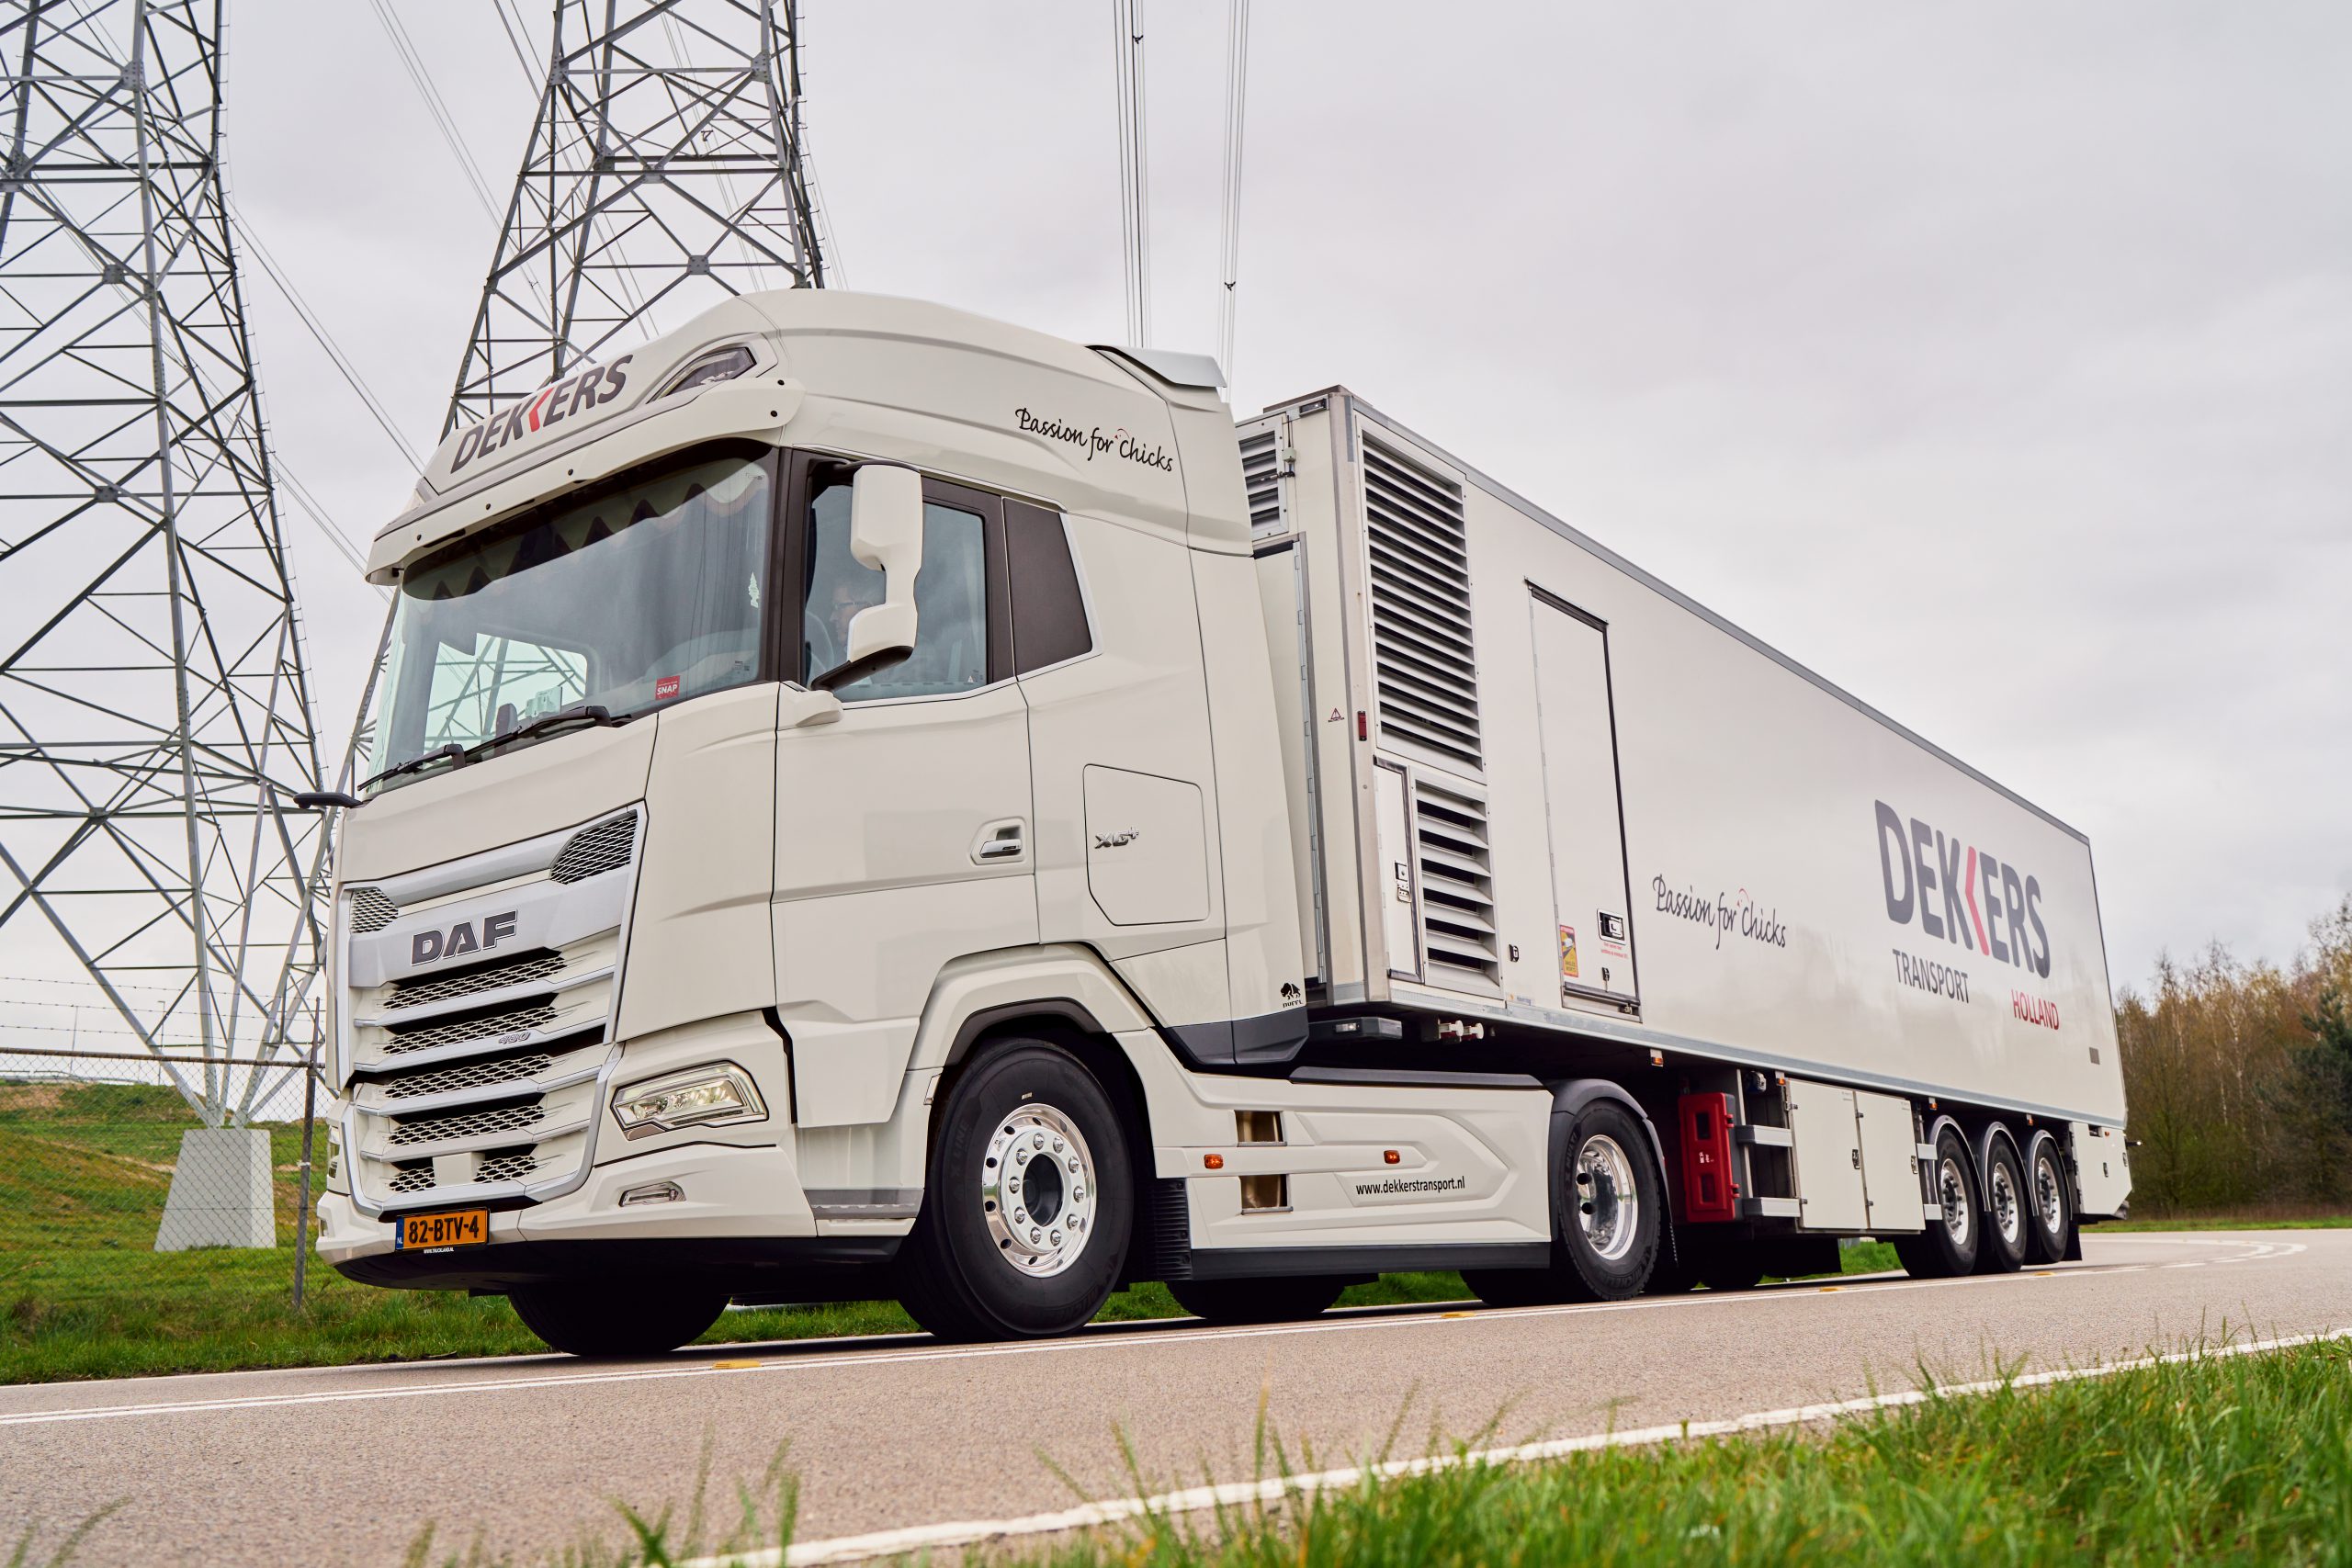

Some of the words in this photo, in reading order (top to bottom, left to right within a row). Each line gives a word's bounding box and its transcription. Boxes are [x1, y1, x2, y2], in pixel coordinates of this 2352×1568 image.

[450, 355, 634, 473] DEKKERS
[1015, 407, 1088, 446] Passion
[1086, 427, 1114, 461] for
[1119, 434, 1173, 472] Chicks
[657, 684, 677, 694] SNAP
[1095, 827, 1139, 850] XG+
[1653, 874, 1715, 927] Passion
[1713, 892, 1737, 950] for
[1741, 899, 1787, 948] Chicks
[1874, 799, 2051, 979] DEKKERS
[411, 910, 517, 966] DAF
[1892, 949, 1969, 1004] TRANSPORT
[2011, 989, 2060, 1031] HOLLAND
[1356, 1176, 1465, 1197] www.dekkerstransport.nl
[397, 1236, 403, 1245] NL
[409, 1215, 479, 1244] 82-BTV-4
